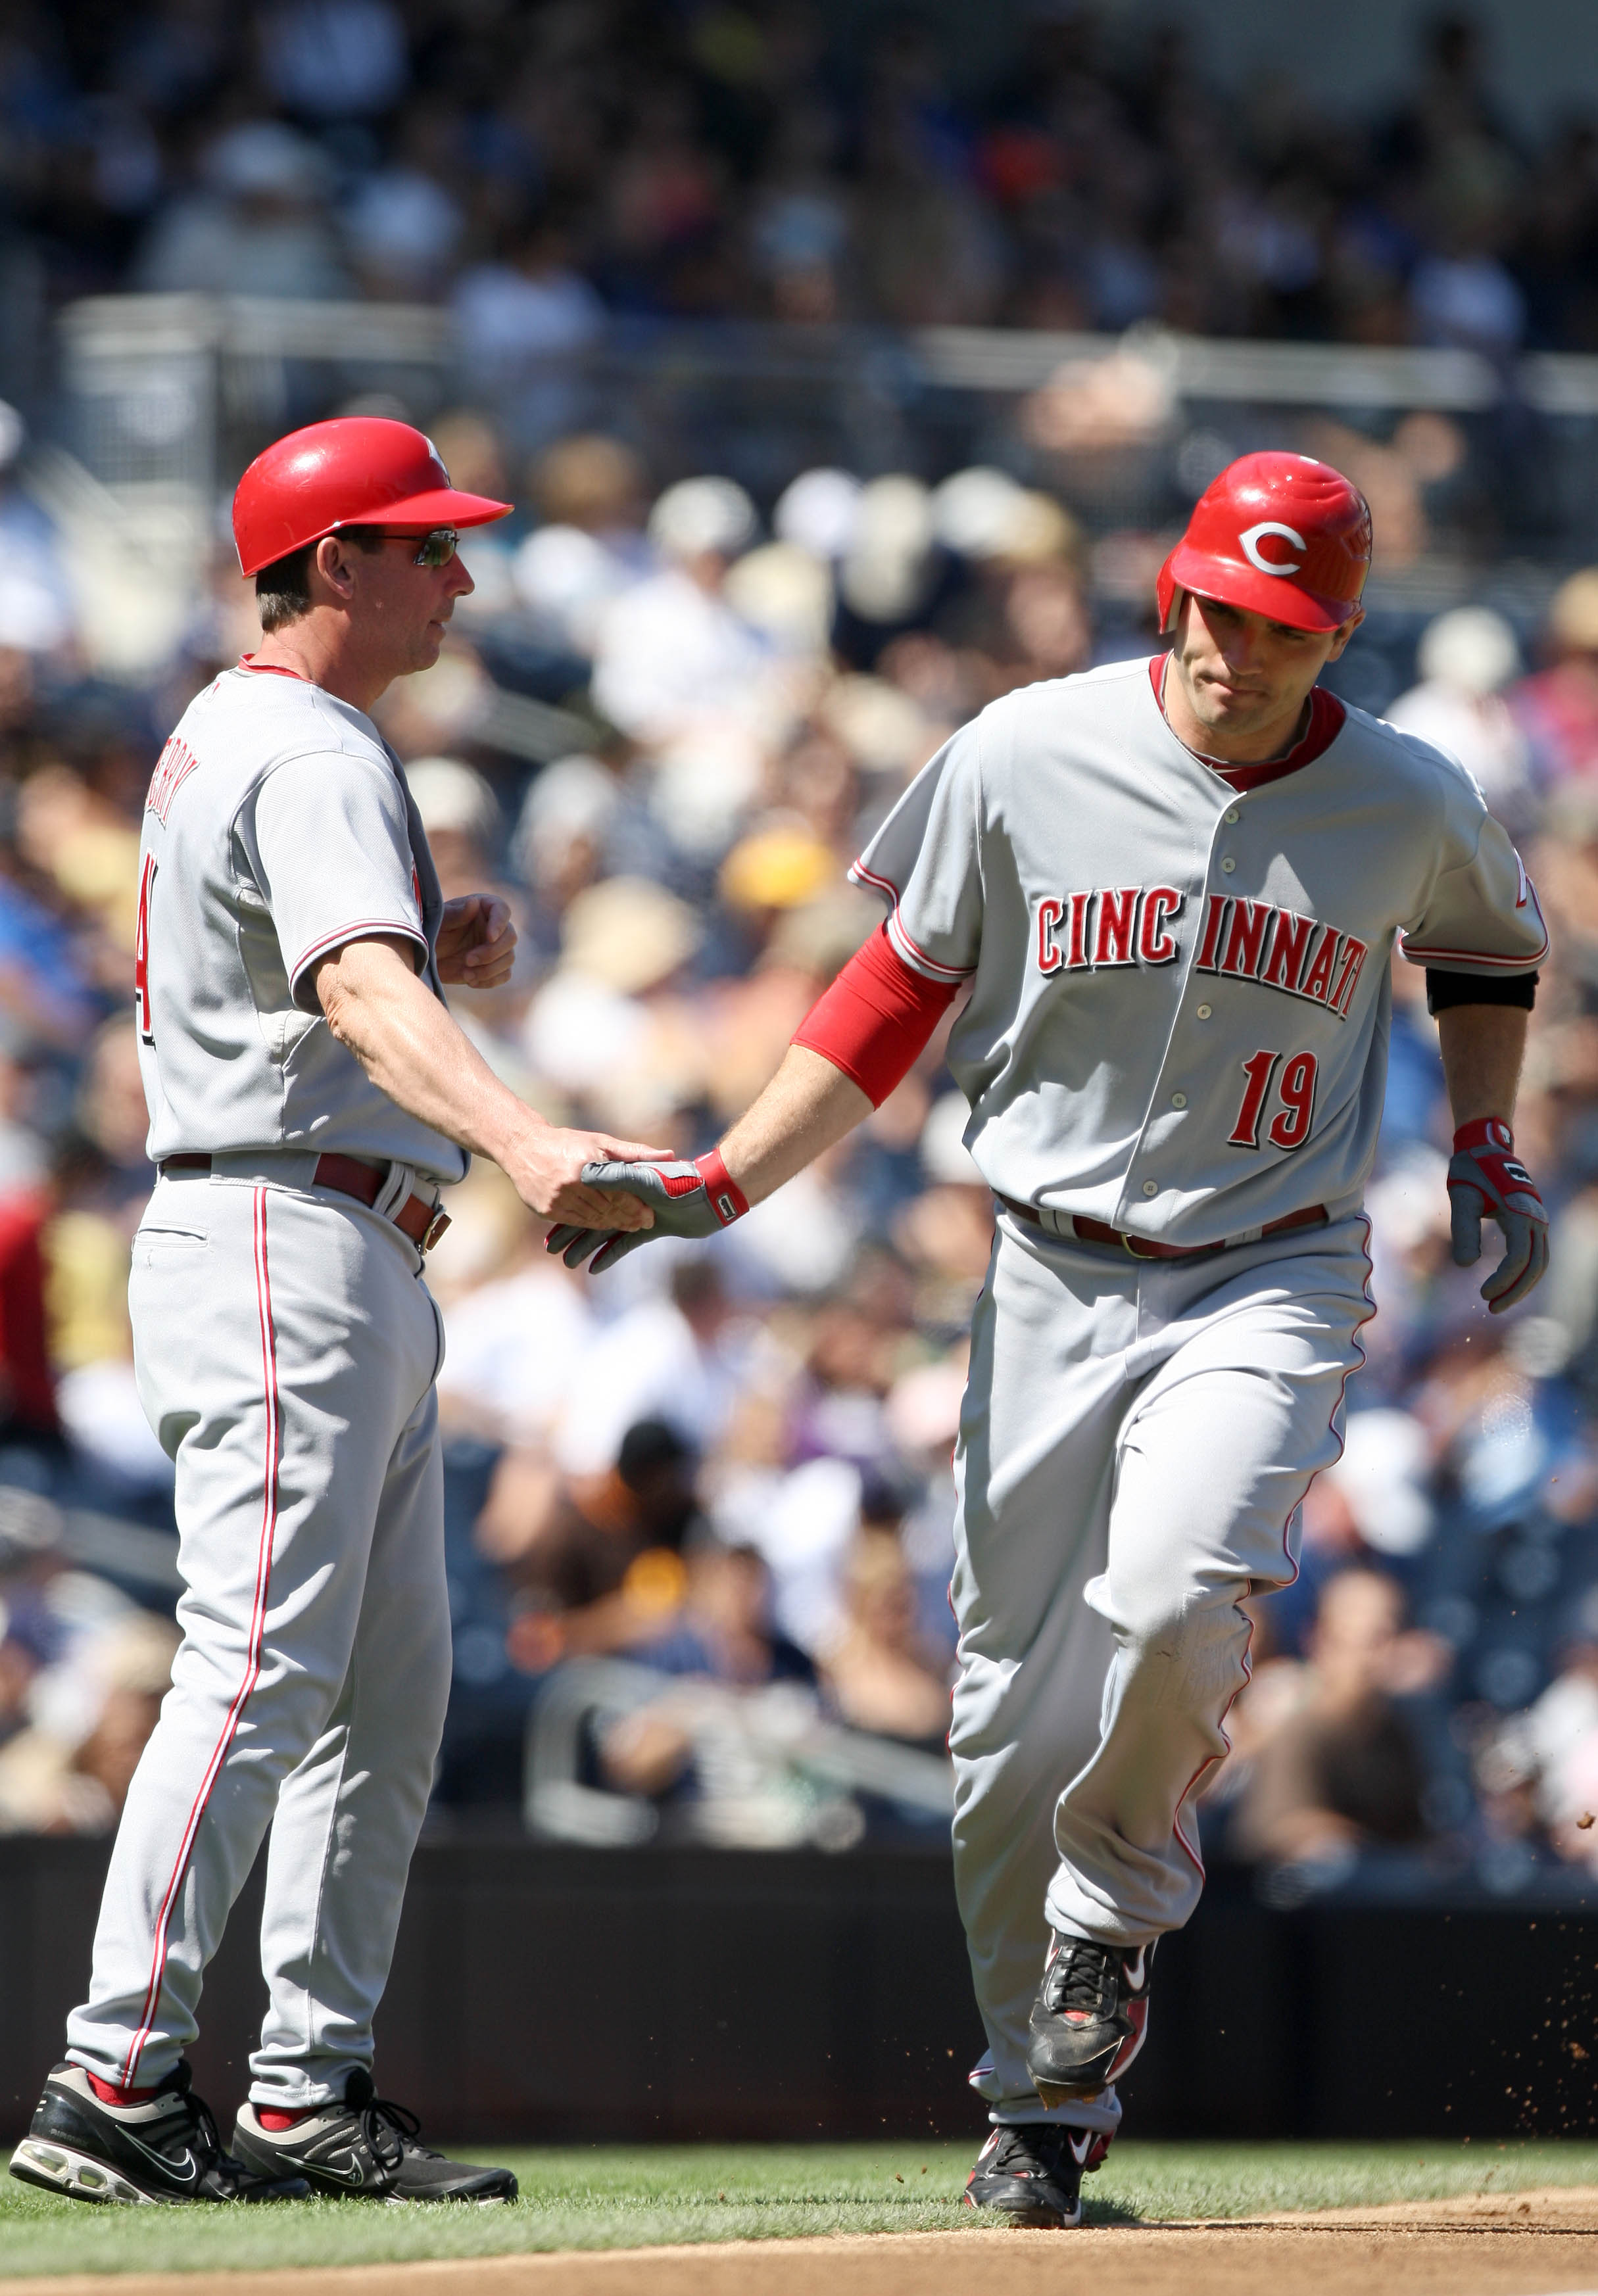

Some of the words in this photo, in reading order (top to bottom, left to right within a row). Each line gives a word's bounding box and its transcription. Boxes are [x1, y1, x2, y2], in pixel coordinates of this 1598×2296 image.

[1238, 521, 1307, 576] C
[145, 736, 200, 831] ERRY
[1226, 1049, 1319, 1151] 19
